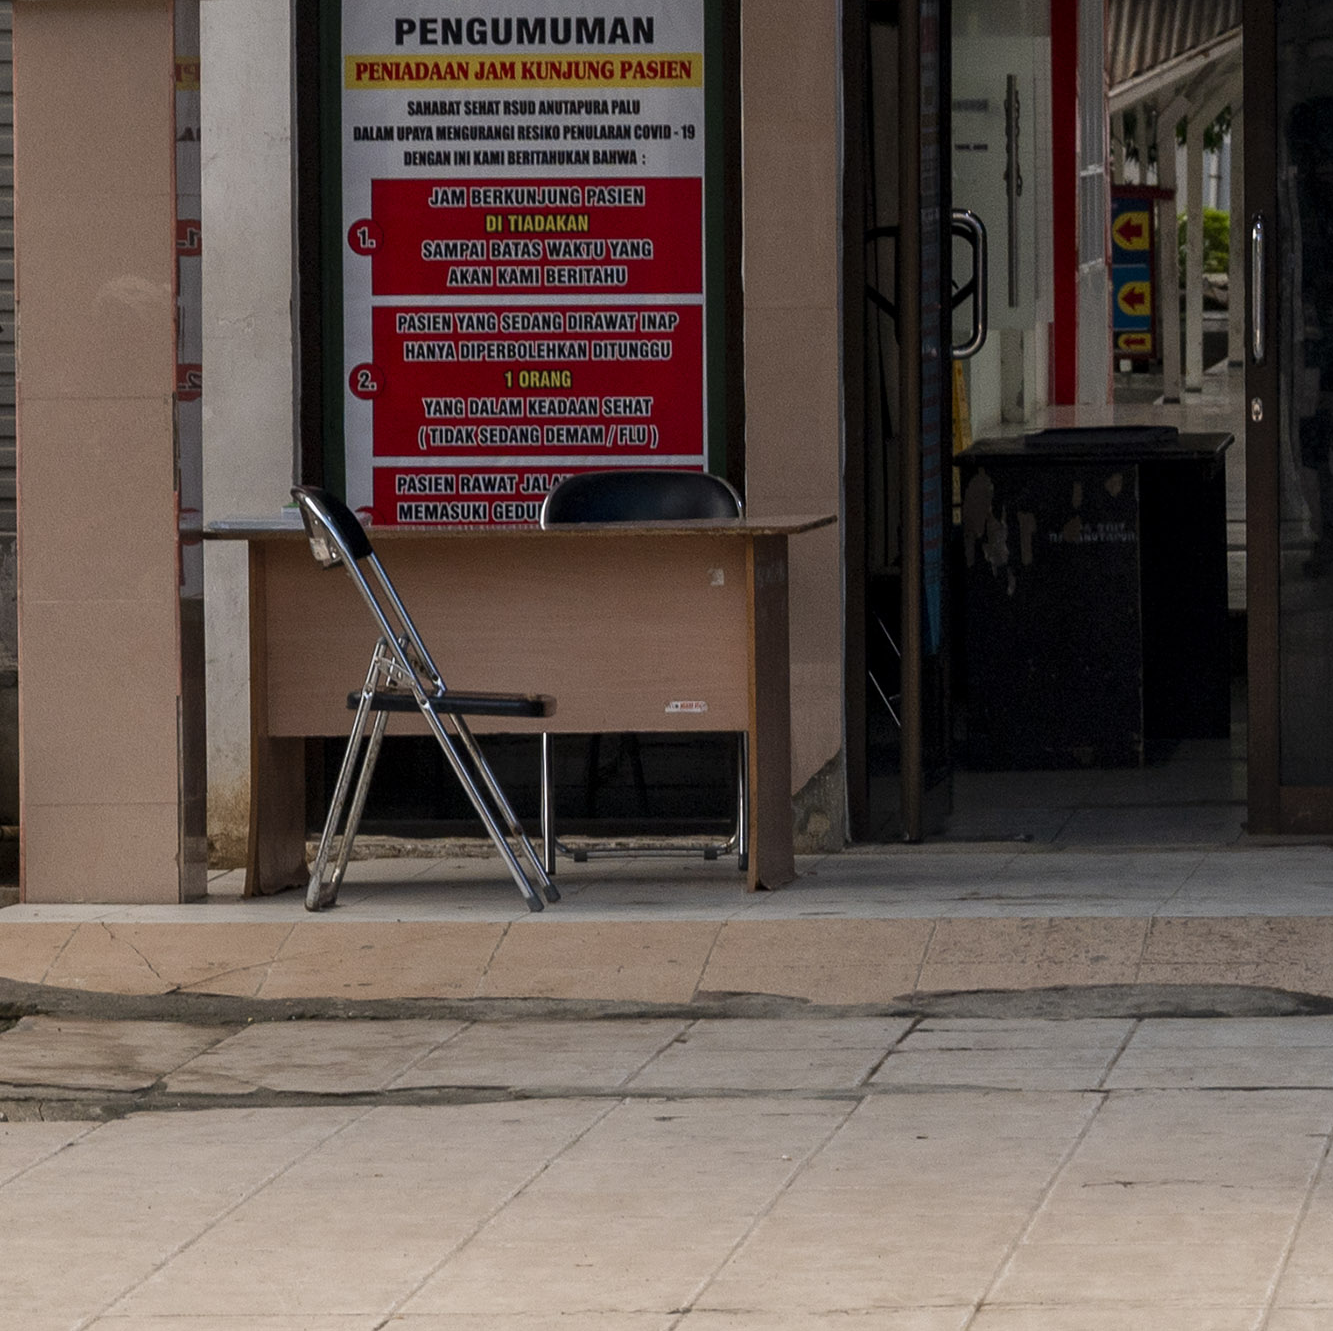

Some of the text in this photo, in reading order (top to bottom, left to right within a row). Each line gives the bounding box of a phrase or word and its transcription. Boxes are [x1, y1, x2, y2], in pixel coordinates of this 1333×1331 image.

[395, 17, 654, 45] PENGUMUMAN
[355, 60, 692, 81] PENIADAAN JAM KUNJUNG PASIEN
[408, 100, 640, 115] SAHABAT SEHAT RSUD ANUTAPURA PALU
[353, 125, 695, 140] DALAM UPAYA MENGURANGI RESIKO PENULARAN COVID 19
[404, 150, 637, 166] DENGAN INI KAMI BERITAHUKAN BAHWA
[429, 187, 644, 206] JAM BERKUNJUNG PASIEN
[486, 215, 589, 232] DI TIADAKAN
[357, 228, 375, 247] 1.
[422, 240, 653, 259] SAMPAI BATAS WAKTU YANG
[447, 267, 627, 285] AKAN KAMI BERITAHU
[397, 313, 678, 333] PASIEN YANG SEDANG DIRAWAT INAP
[404, 341, 672, 361] HANYA DIPERBOLEHKAN DITUNGGU
[357, 371, 376, 391] 2.
[504, 370, 571, 388] 1 ORANG
[423, 397, 652, 417] YANG DALAM KEADAAN SEHAT
[430, 426, 646, 445] TIDAK SEDANG DEMAM FLU
[397, 475, 573, 494] PASIEN RAWAT JALA
[399, 503, 487, 521] MEMASUKI
